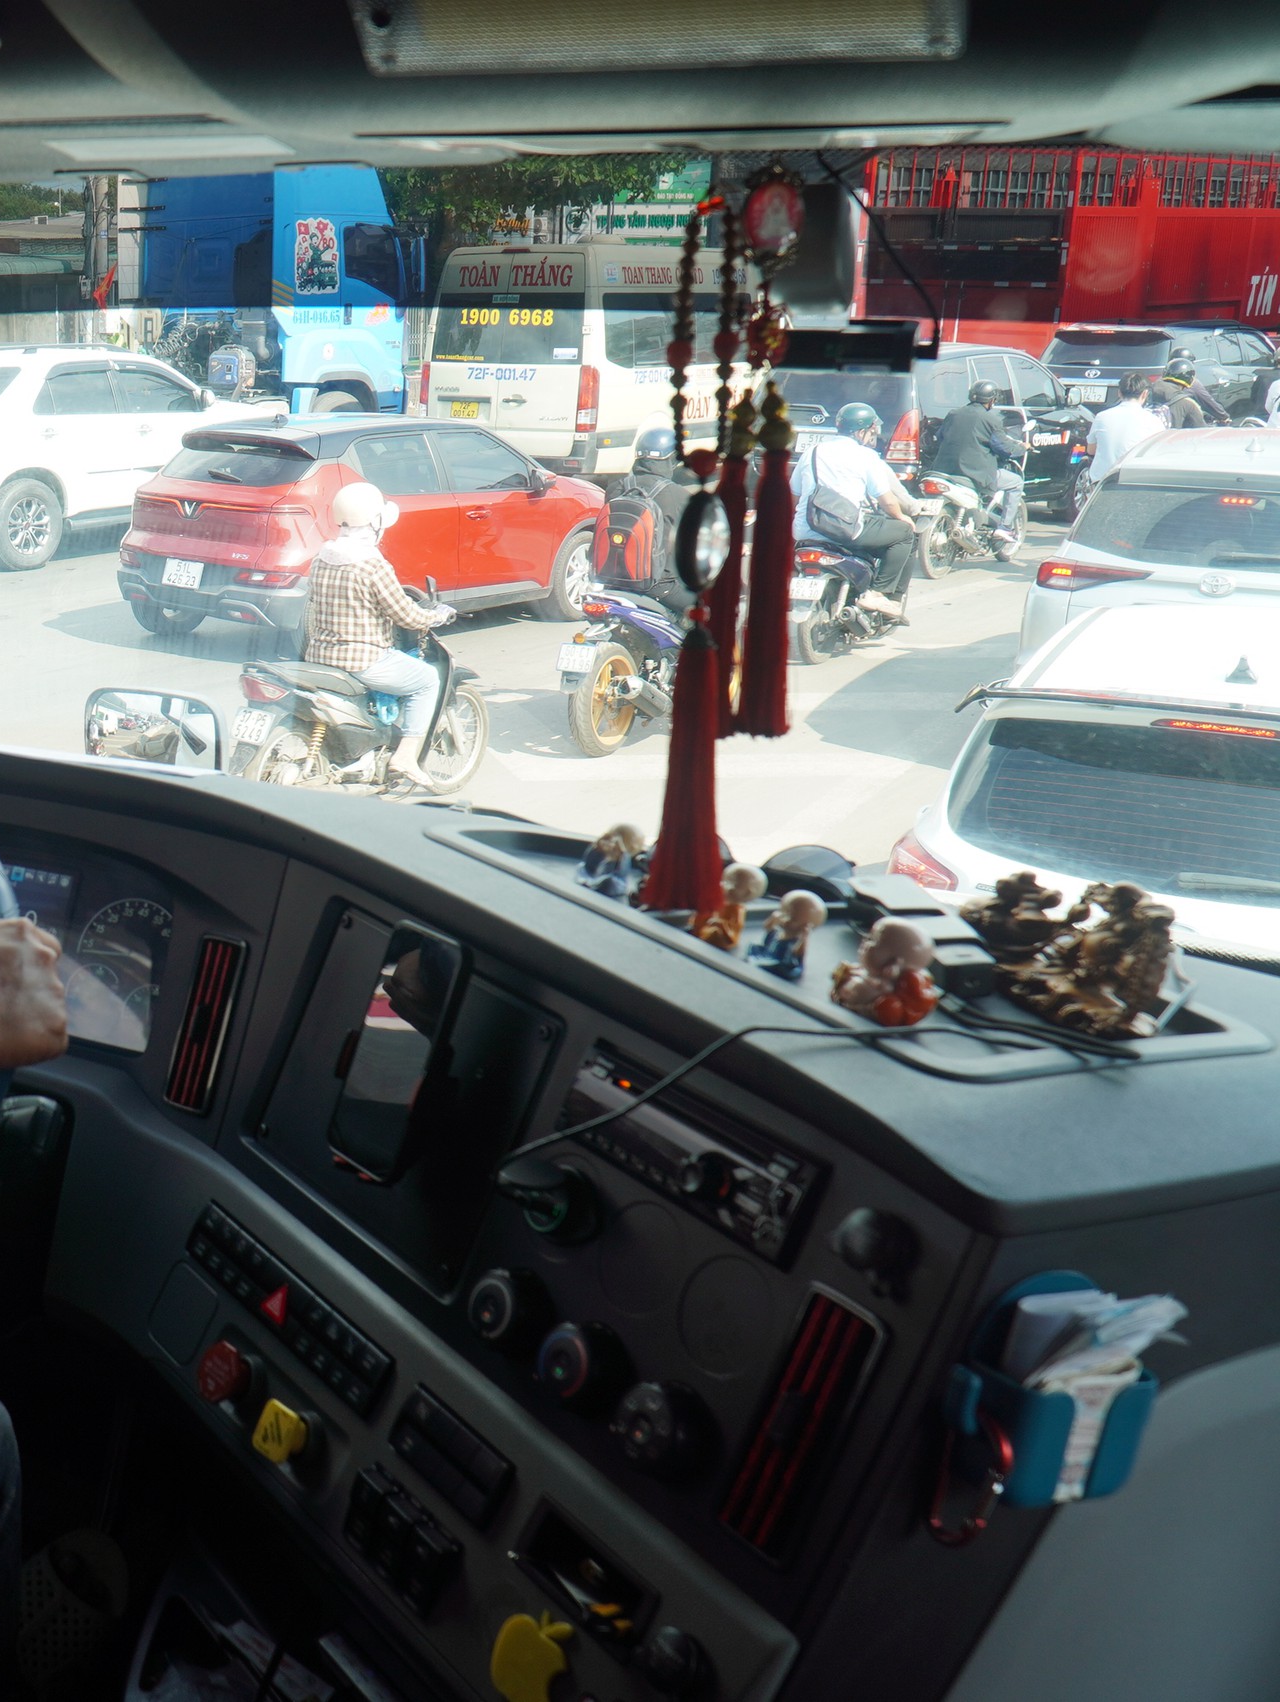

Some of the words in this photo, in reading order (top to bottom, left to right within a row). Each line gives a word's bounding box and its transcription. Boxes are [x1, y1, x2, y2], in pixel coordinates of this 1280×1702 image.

[459, 260, 501, 287] TOÀN
[511, 256, 573, 287] THẮNG
[622, 267, 644, 284] TOAN
[645, 266, 673, 284] THANG
[1246, 266, 1278, 317] TÍN
[460, 308, 501, 326] 1900
[509, 308, 554, 326] 6968
[467, 367, 537, 381] 72F-001.47
[459, 402, 471, 410] 72F
[685, 390, 711, 420] OÀN
[176, 561, 191, 574] 51L
[122, 908, 135, 917] 35
[137, 907, 149, 917] 45
